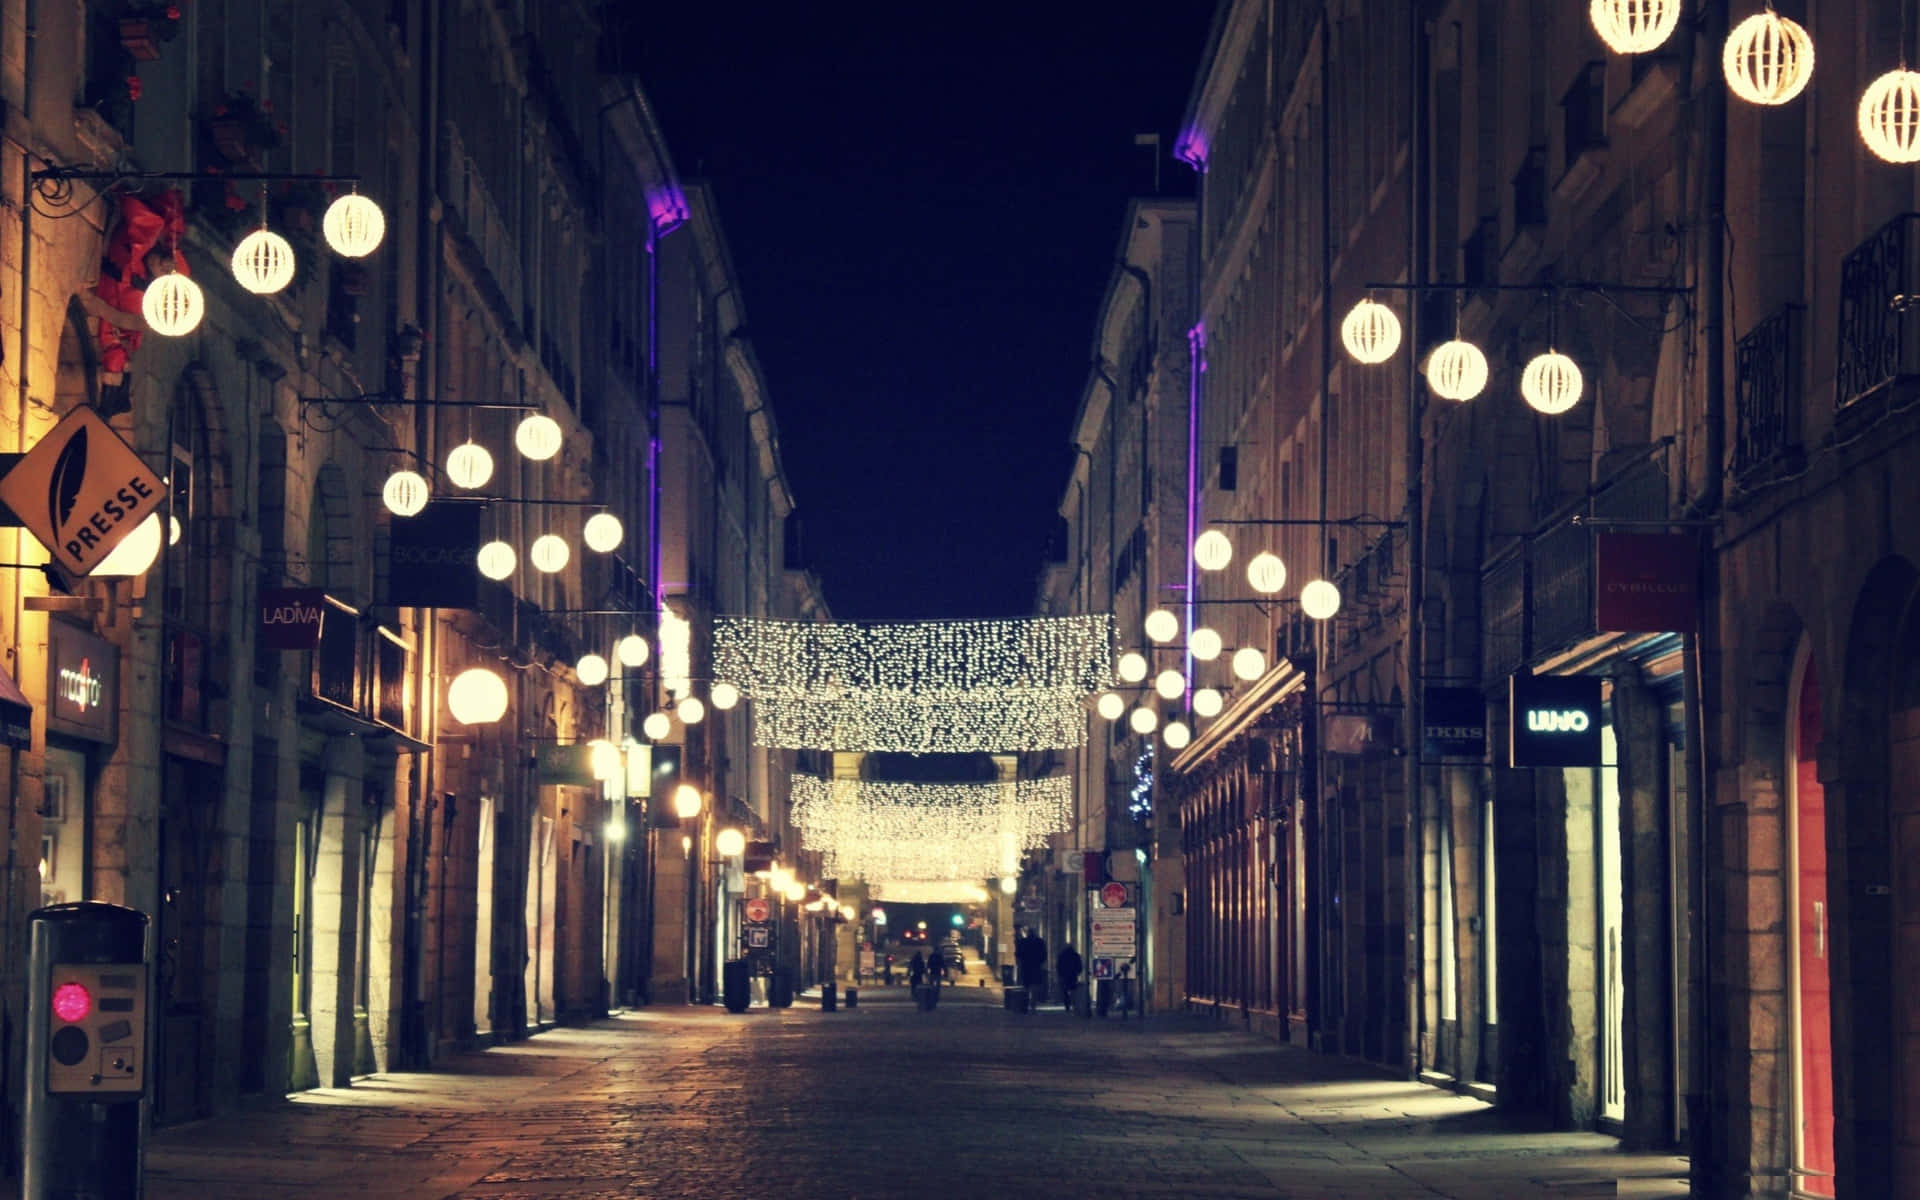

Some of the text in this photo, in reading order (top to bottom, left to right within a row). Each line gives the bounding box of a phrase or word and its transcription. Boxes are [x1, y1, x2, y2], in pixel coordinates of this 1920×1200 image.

[65, 476, 153, 562] PRESSE
[394, 545, 473, 563] BOCAGE
[263, 607, 320, 624] LADIVA
[1426, 726, 1483, 738] IKKS
